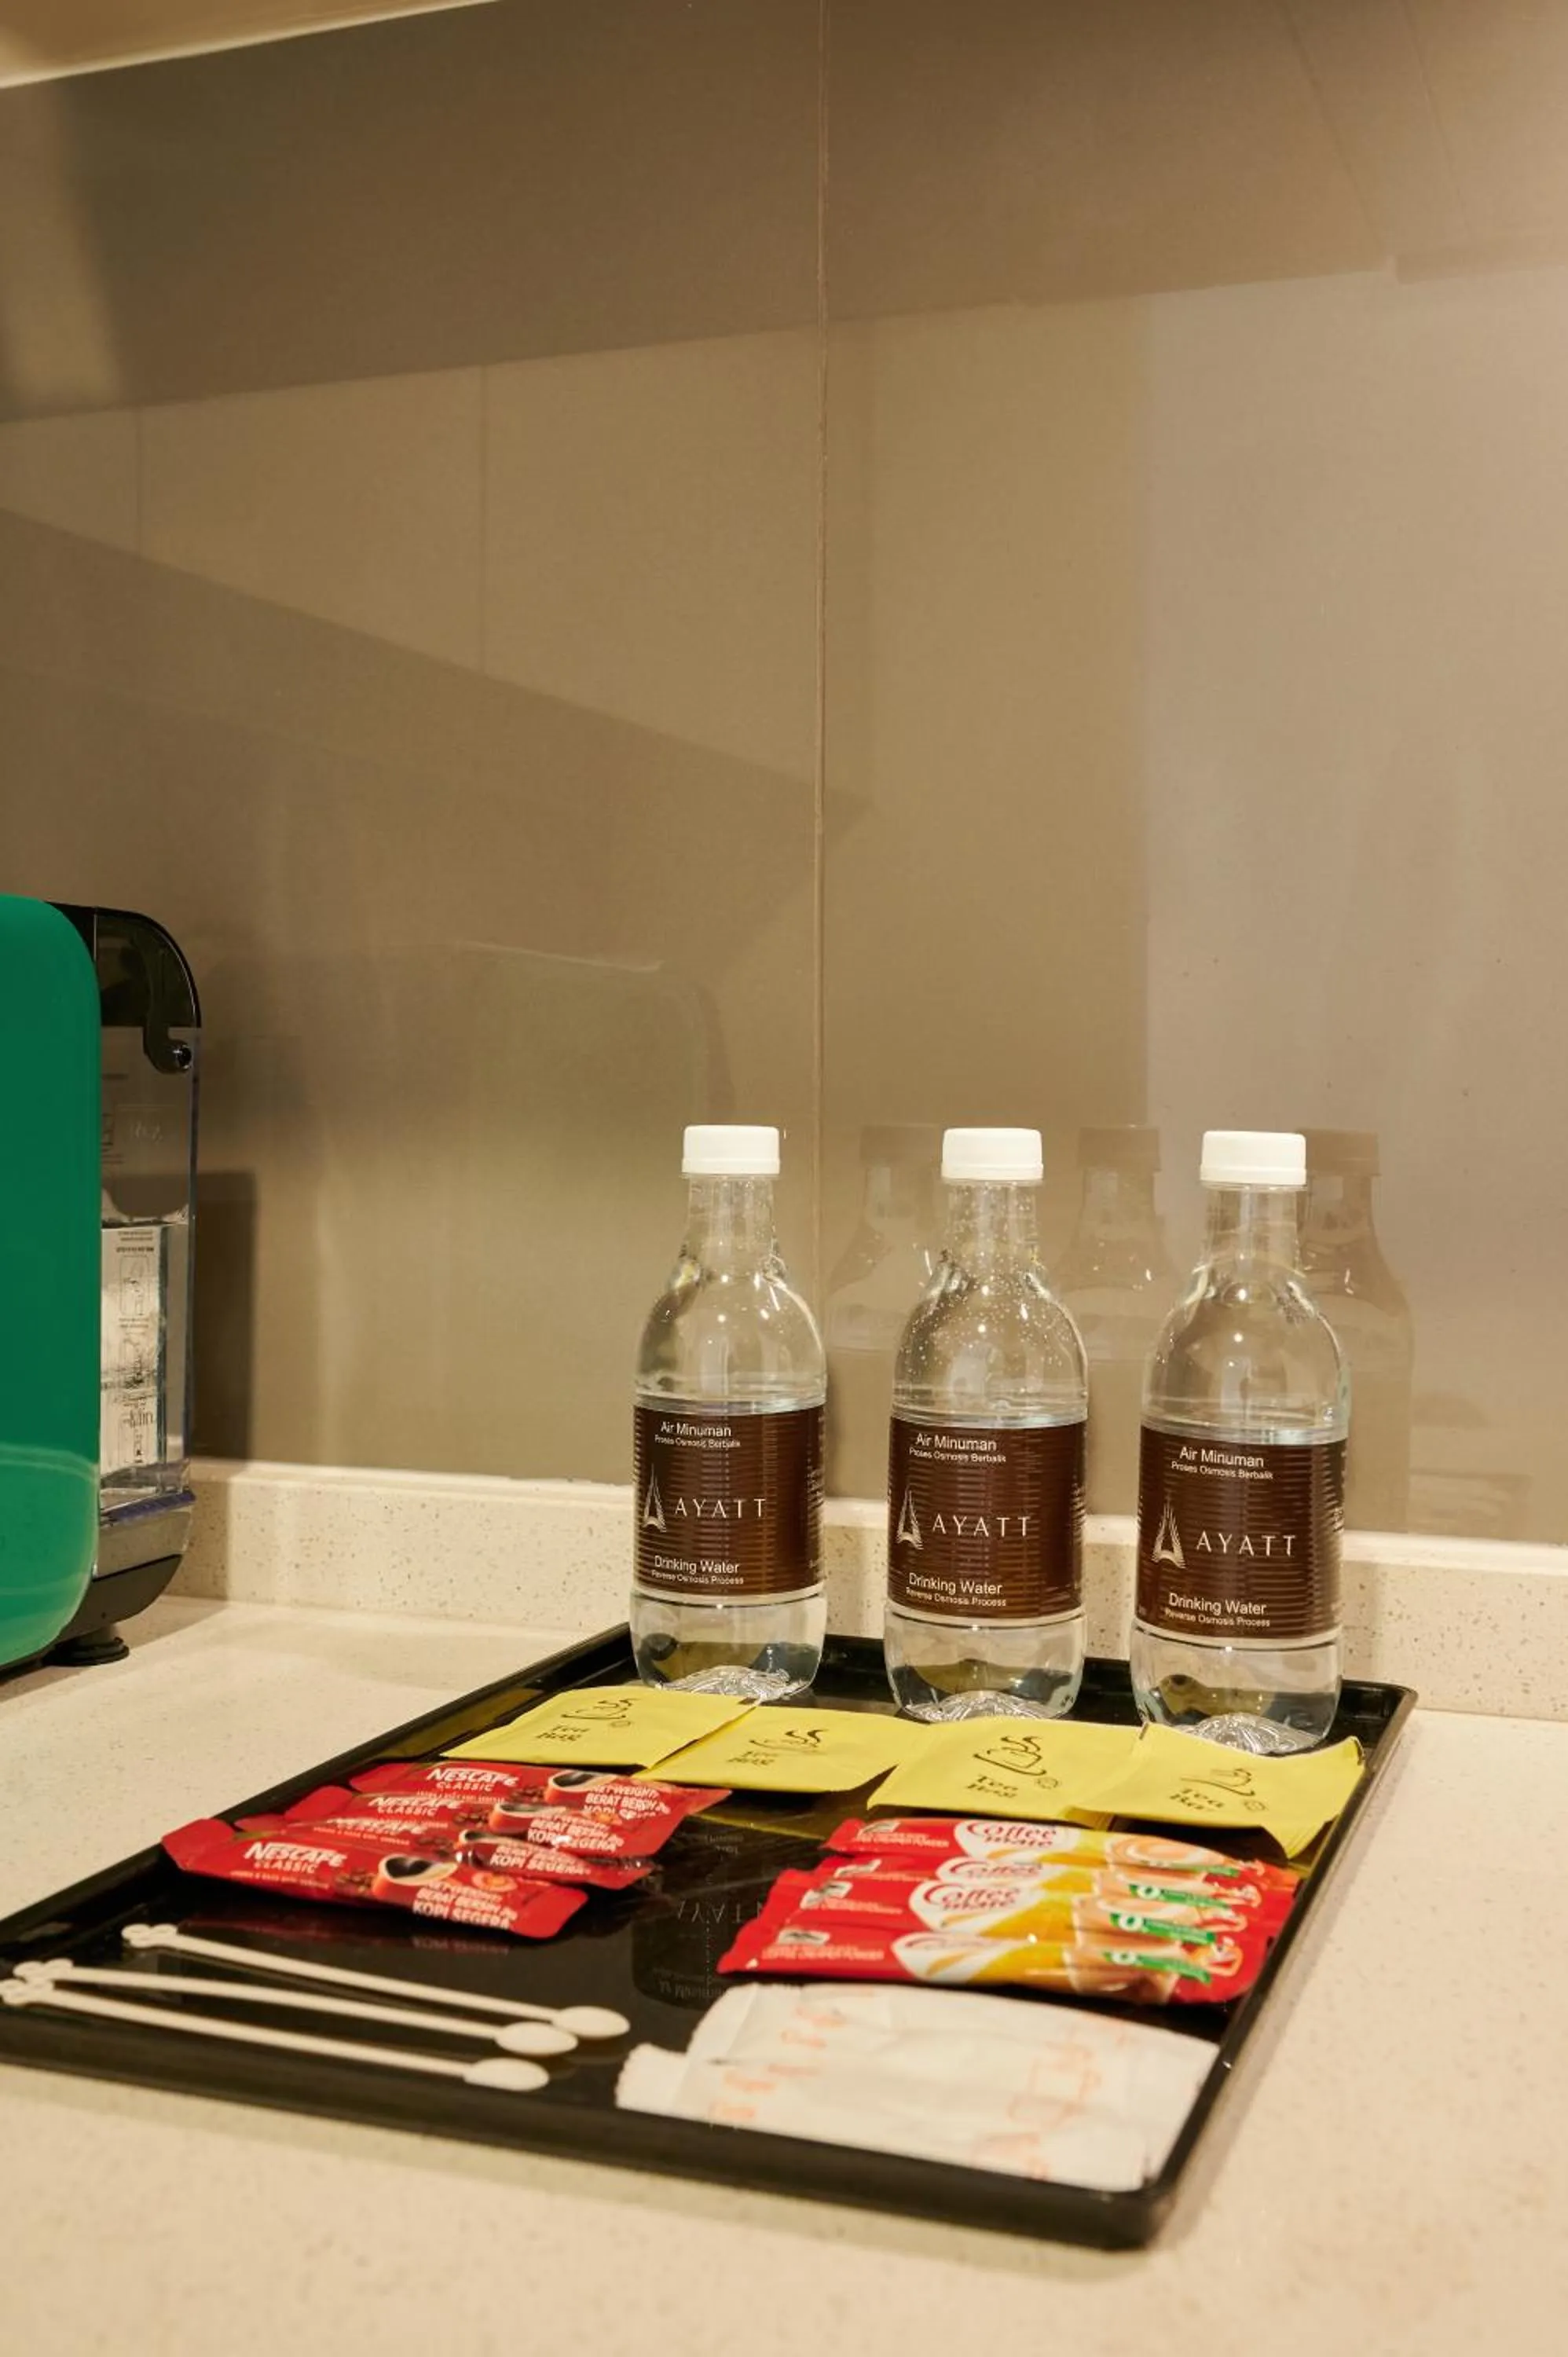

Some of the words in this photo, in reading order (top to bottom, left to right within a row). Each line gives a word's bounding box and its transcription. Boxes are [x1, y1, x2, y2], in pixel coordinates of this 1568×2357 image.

[661, 1420, 675, 1433] Air
[676, 1423, 731, 1437] Minuman
[916, 1432, 932, 1446] Air
[934, 1435, 997, 1451] Minuman
[1179, 1446, 1198, 1461] Air
[1201, 1448, 1264, 1468] Minuman
[675, 1497, 767, 1519] AYATT
[932, 1513, 1031, 1538] AYATT
[1196, 1530, 1295, 1556] AYATT
[654, 1555, 697, 1575] Drinking
[700, 1560, 740, 1574] Water
[909, 1572, 956, 1594] Drinking
[960, 1579, 1003, 1595] Water
[1168, 1592, 1221, 1615] Drinking
[1225, 1599, 1267, 1615] Water
[436, 1781, 495, 1792] CLASSIC
[584, 1792, 622, 1807] BERAT
[377, 1805, 438, 1817] CLASSIC
[254, 1859, 319, 1875] CLASSIC
[489, 1853, 526, 1869] KOPI
[412, 1898, 450, 1919] KOPI
